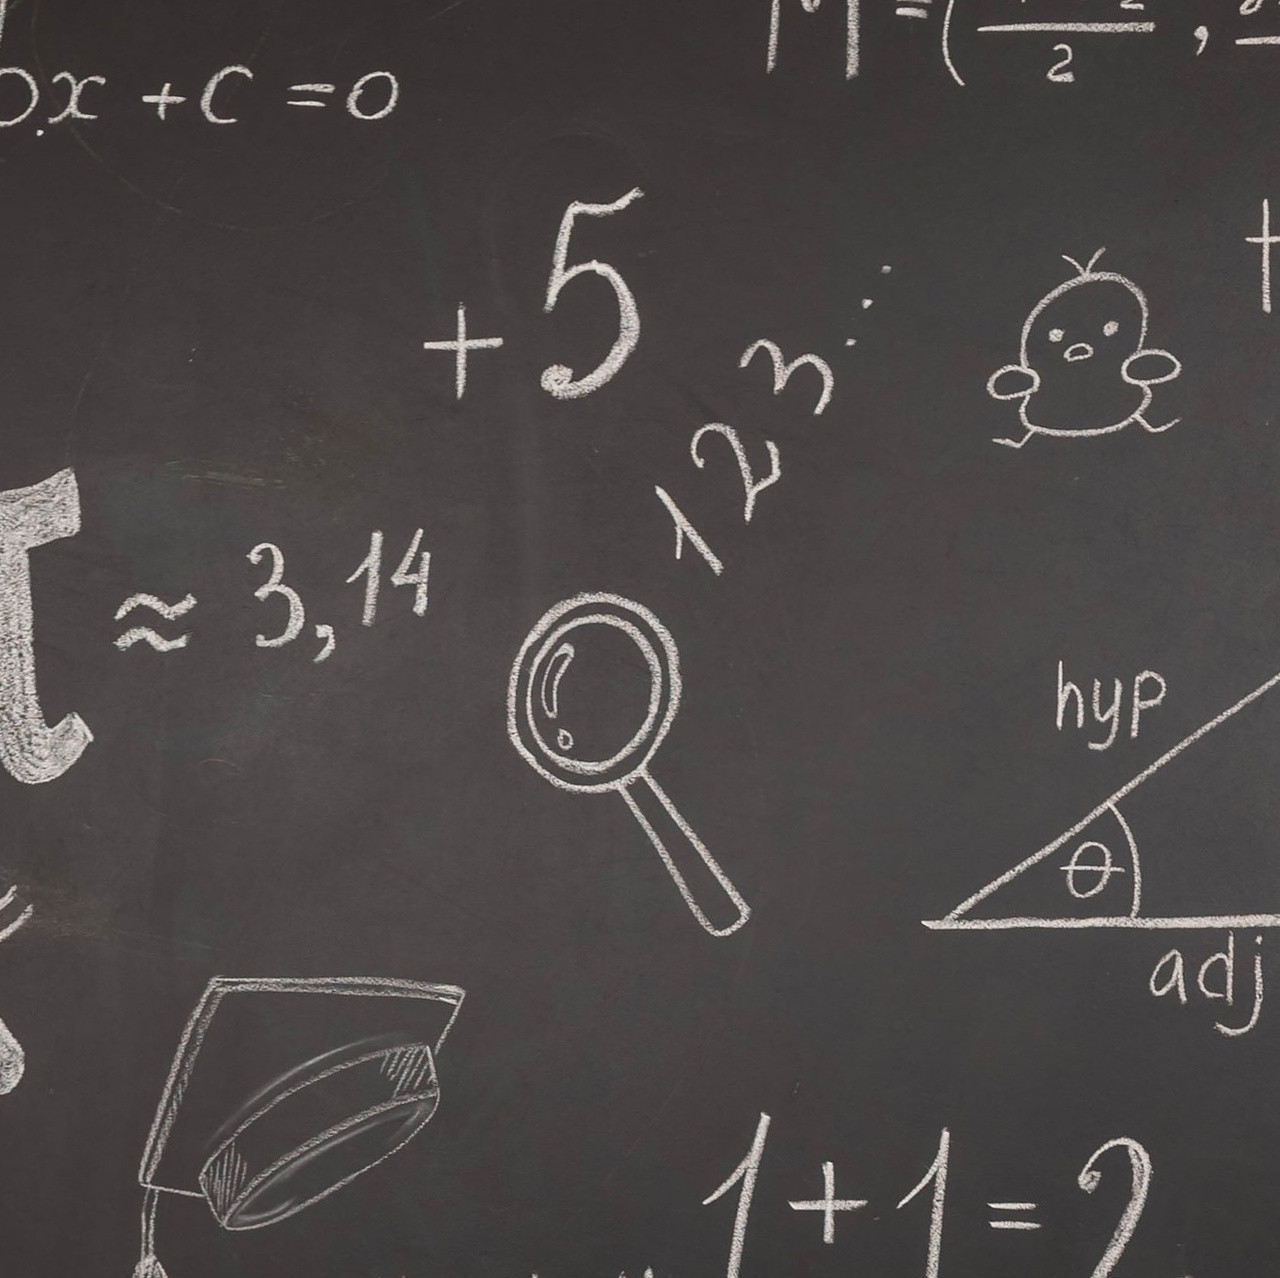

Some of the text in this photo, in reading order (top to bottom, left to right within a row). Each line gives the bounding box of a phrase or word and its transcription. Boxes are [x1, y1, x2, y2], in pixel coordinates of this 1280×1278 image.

[246, 529, 431, 663] 3,14
[1057, 660, 1167, 751] hyp
[1149, 930, 1264, 1037] adj
